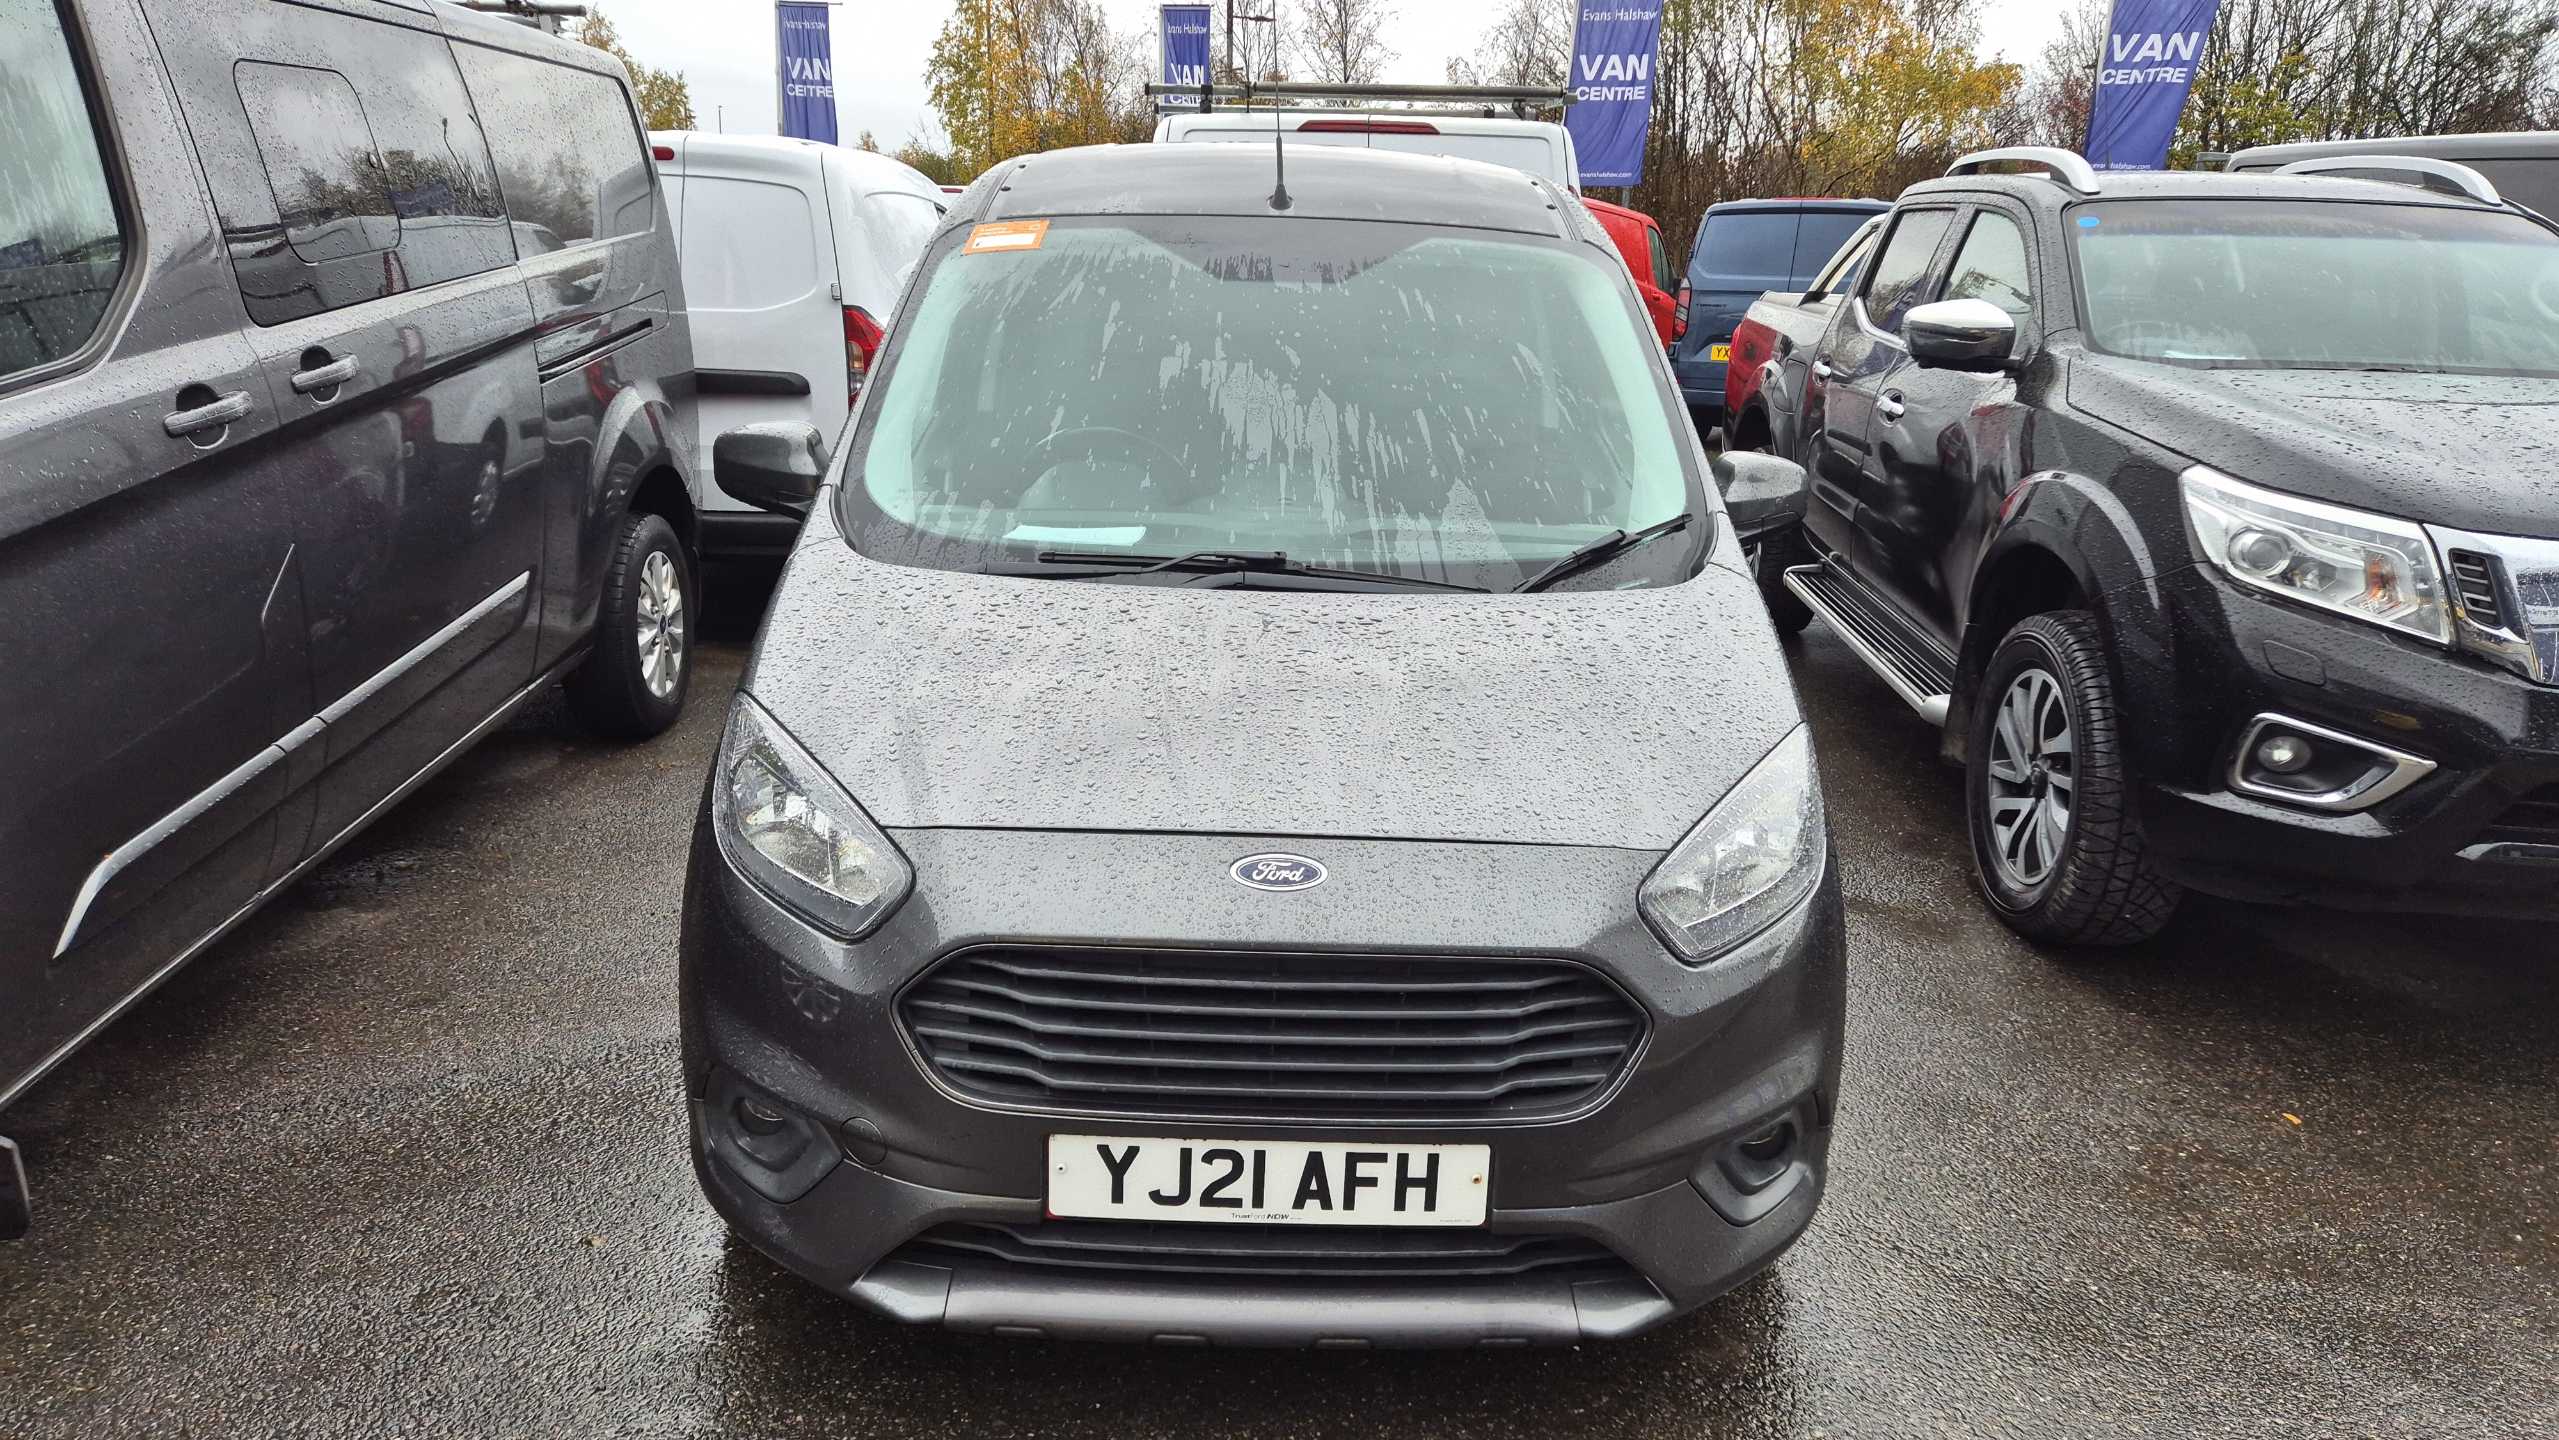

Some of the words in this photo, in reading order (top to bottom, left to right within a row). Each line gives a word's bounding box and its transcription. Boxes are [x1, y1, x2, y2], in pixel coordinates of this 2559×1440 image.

[1583, 9, 1611, 22] Evans
[1614, 8, 1658, 21] Halshaw
[2112, 31, 2200, 63] VAN
[786, 56, 832, 80] VAN
[1170, 62, 1205, 86] VAN
[1579, 53, 1649, 81] VAN
[2100, 66, 2188, 85] CENTRE
[1577, 86, 1646, 101] CENTRE
[1252, 861, 1305, 882] Ford
[1096, 1144, 1267, 1210] YJ21
[1292, 1151, 1440, 1213] AFH
[1266, 1213, 1289, 1221] NOW
